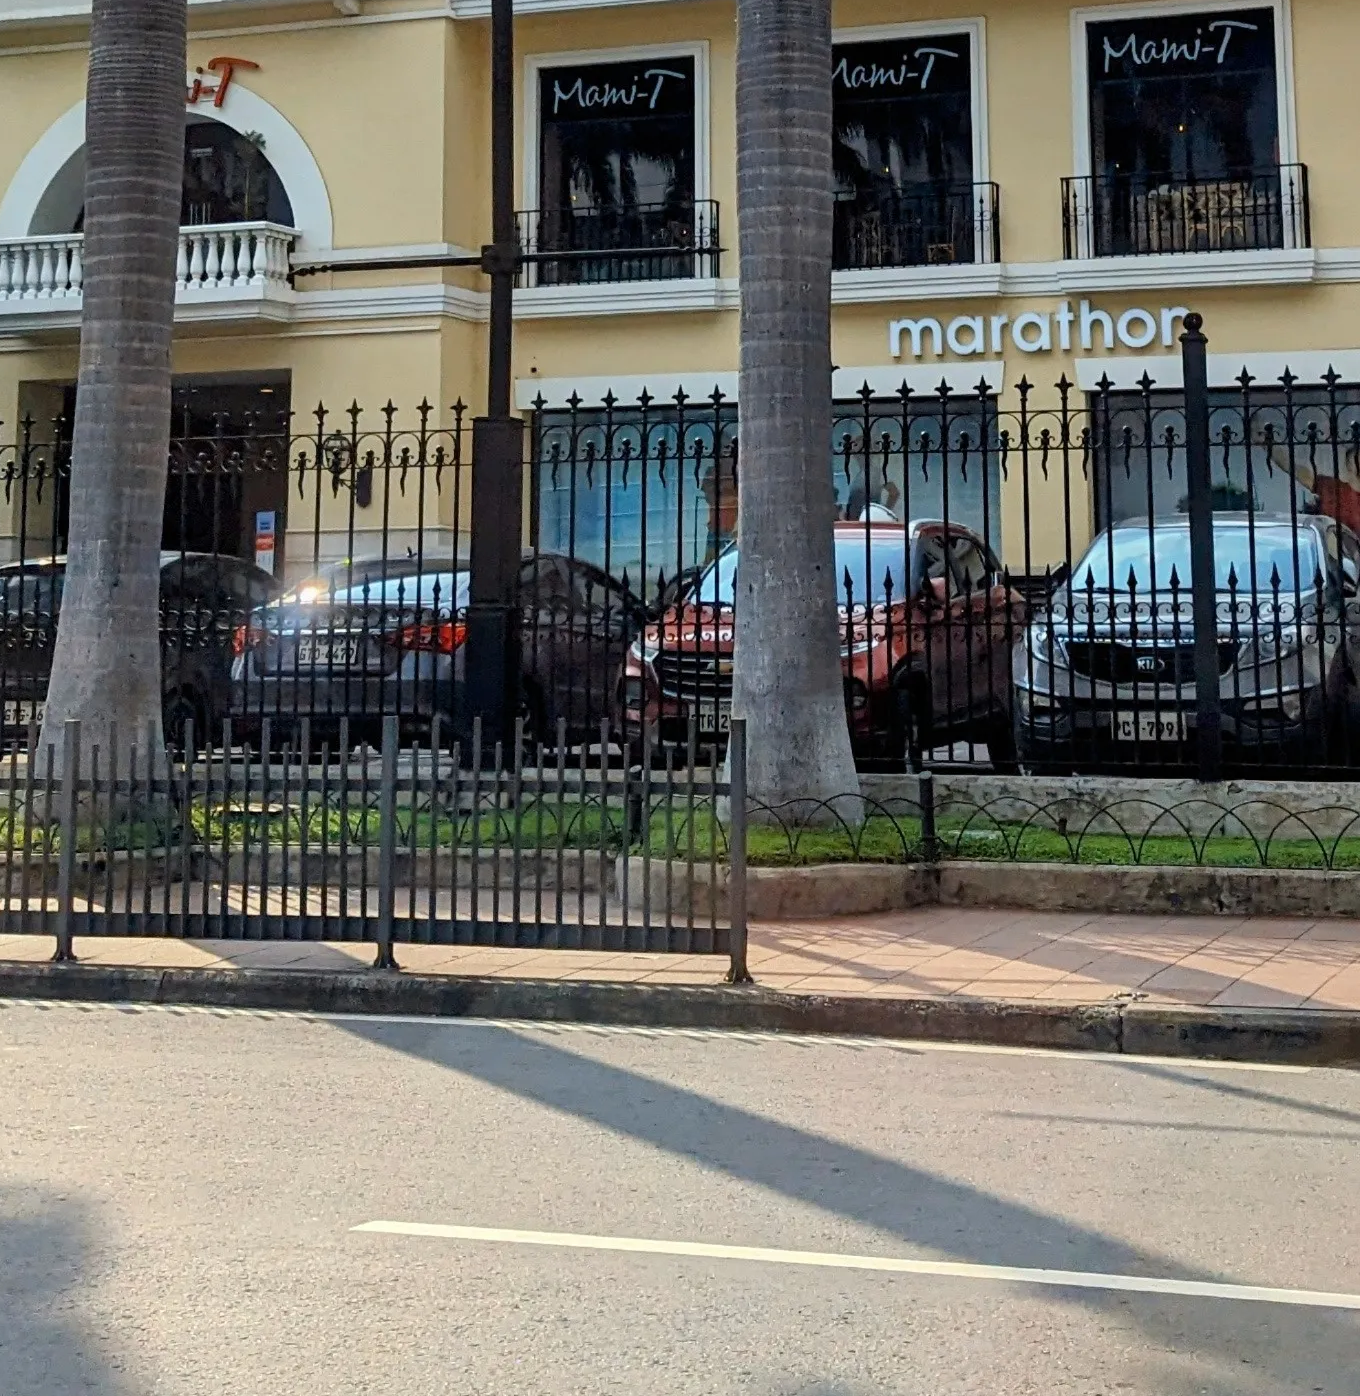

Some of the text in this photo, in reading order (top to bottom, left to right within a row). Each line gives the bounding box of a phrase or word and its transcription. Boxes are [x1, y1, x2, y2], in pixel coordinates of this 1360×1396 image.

[1103, 20, 1258, 73] Mami-T
[186, 56, 261, 108] i-T
[553, 69, 686, 115] Mami-T
[889, 299, 1193, 358] marathon
